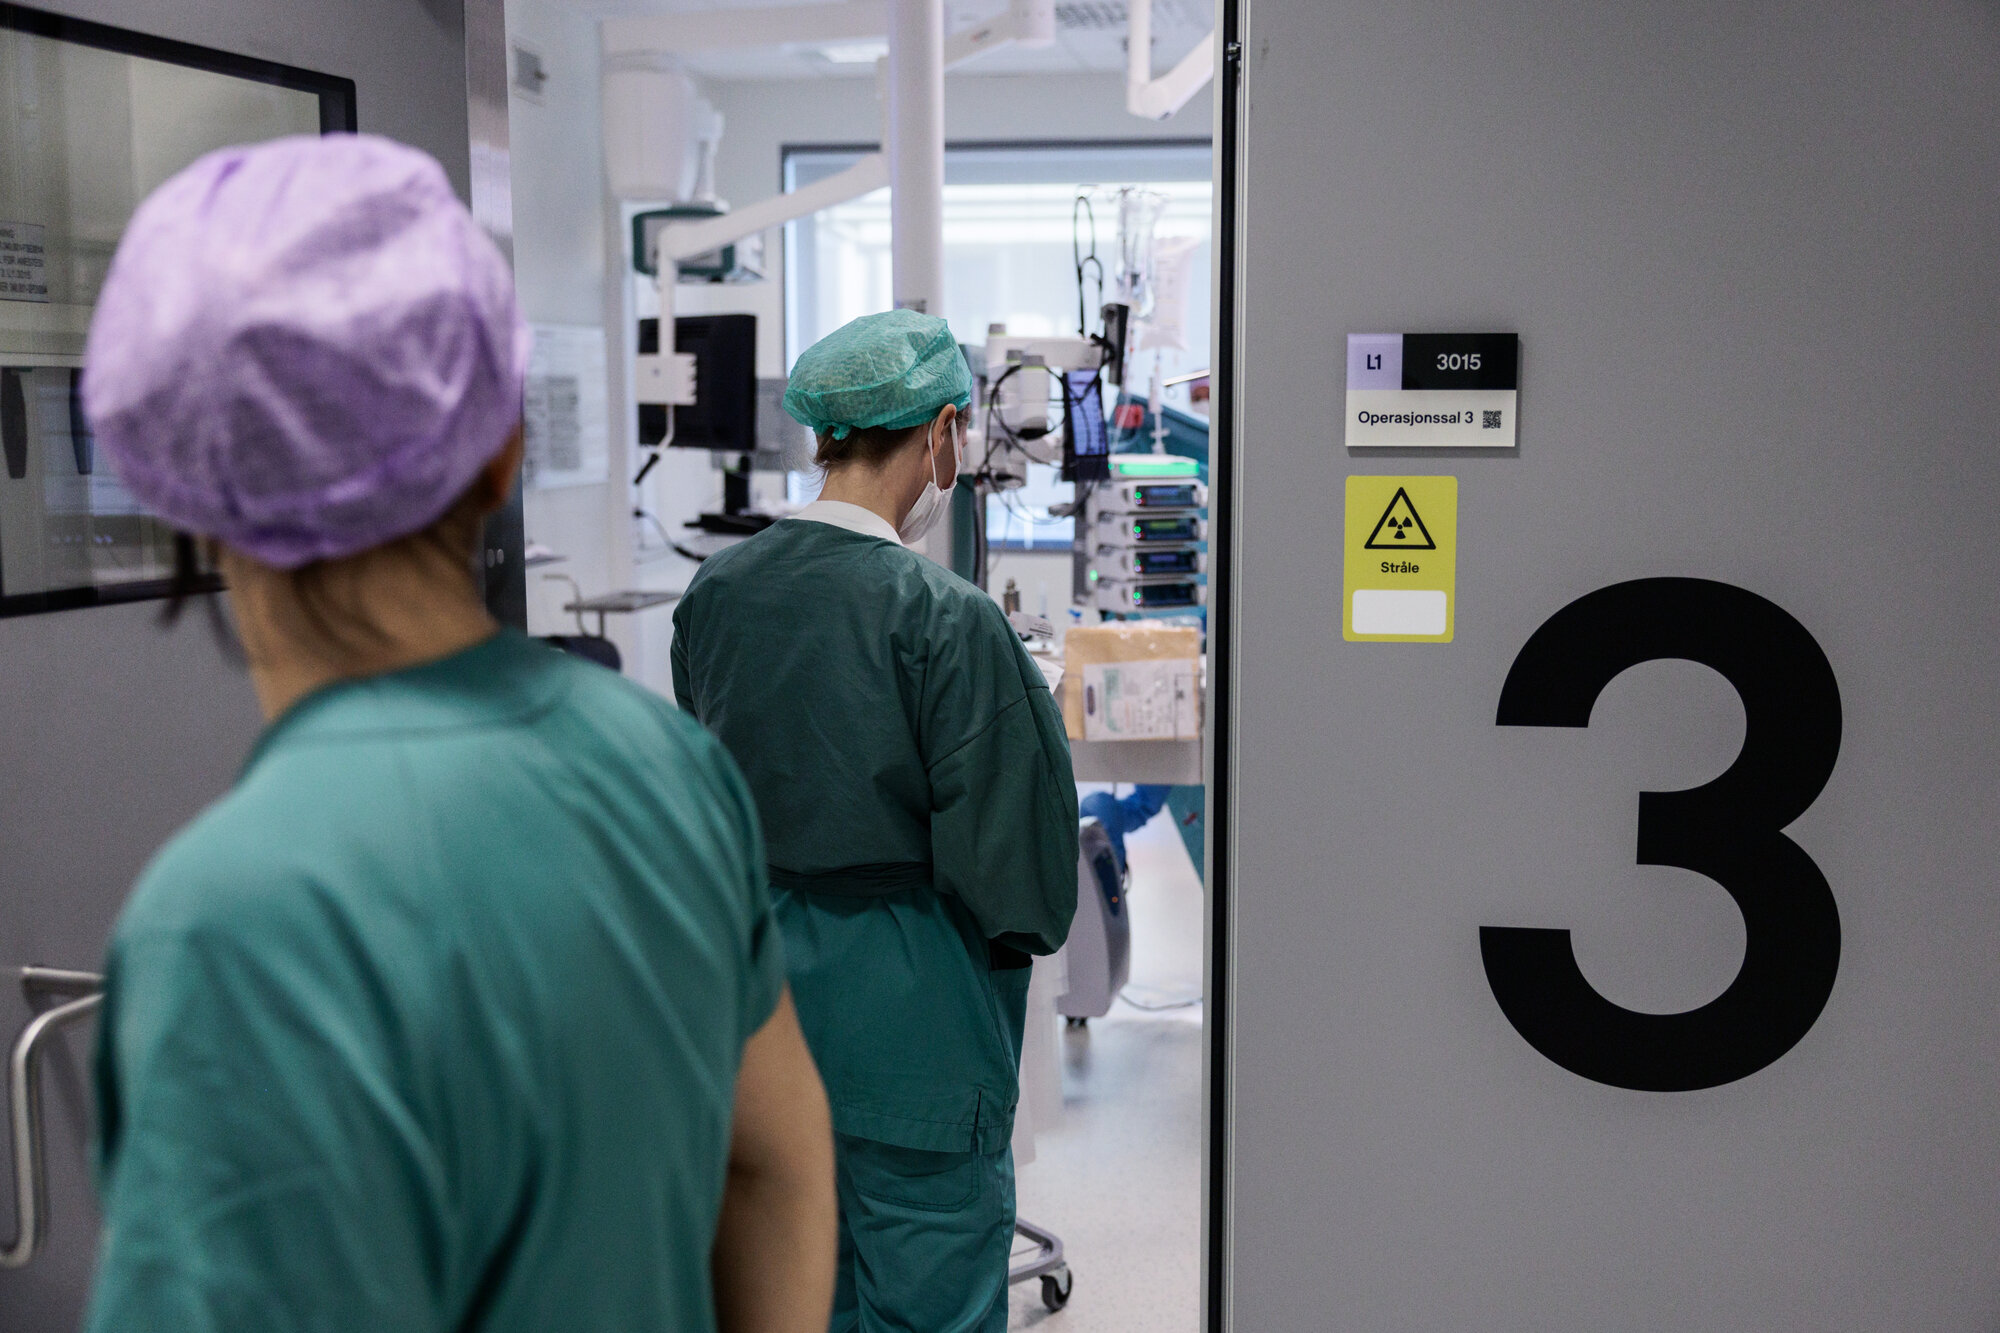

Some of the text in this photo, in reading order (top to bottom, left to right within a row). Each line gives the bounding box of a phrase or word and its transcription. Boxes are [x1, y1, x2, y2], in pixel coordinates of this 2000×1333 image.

[1366, 353, 1382, 371] L1
[1436, 353, 1482, 371] 3015
[1357, 410, 1475, 425] Operasjonssal 3
[1380, 561, 1420, 574] Stråle
[1479, 576, 1843, 1092] 3
